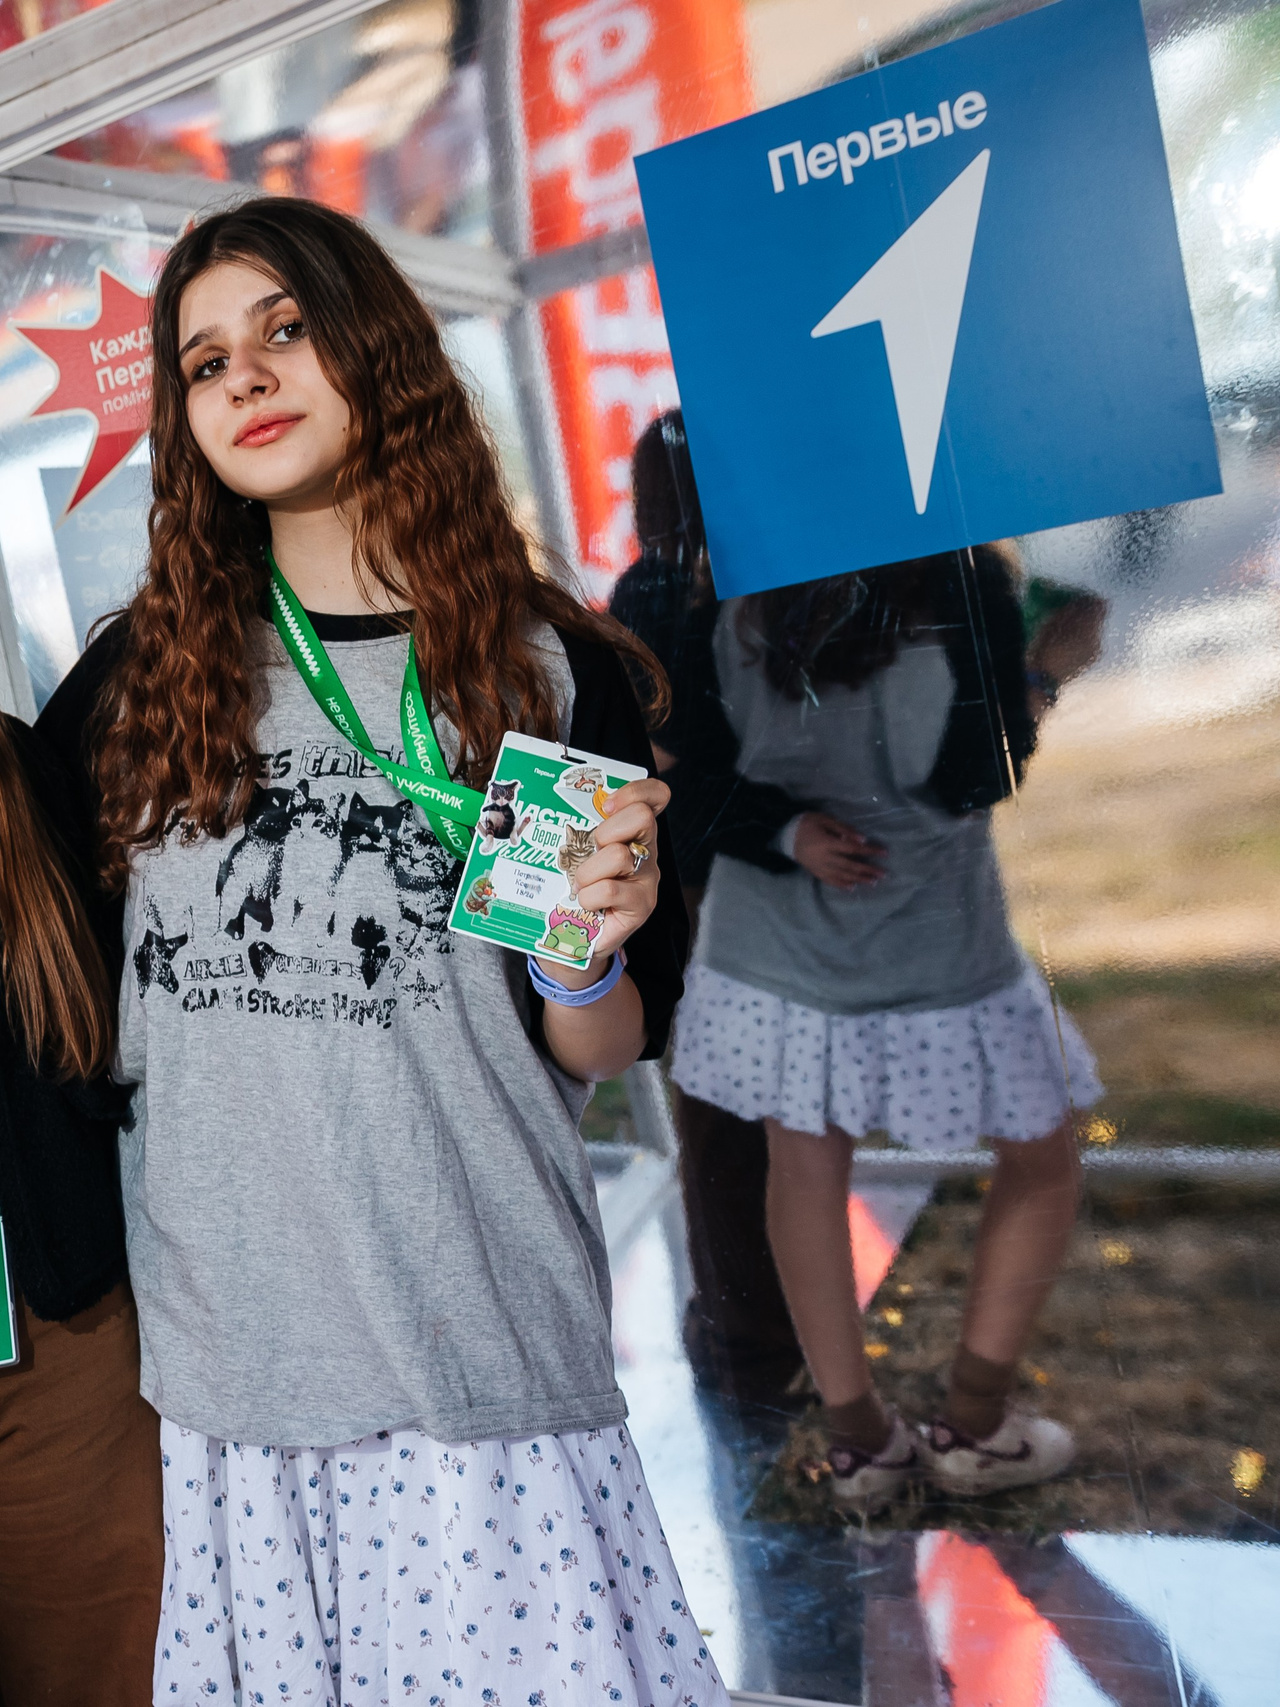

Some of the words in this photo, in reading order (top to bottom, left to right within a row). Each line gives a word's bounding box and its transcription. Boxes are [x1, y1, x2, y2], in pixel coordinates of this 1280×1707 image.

[767, 90, 988, 194] Первые
[89, 326, 154, 365] Кажд
[531, 823, 562, 847] берег
